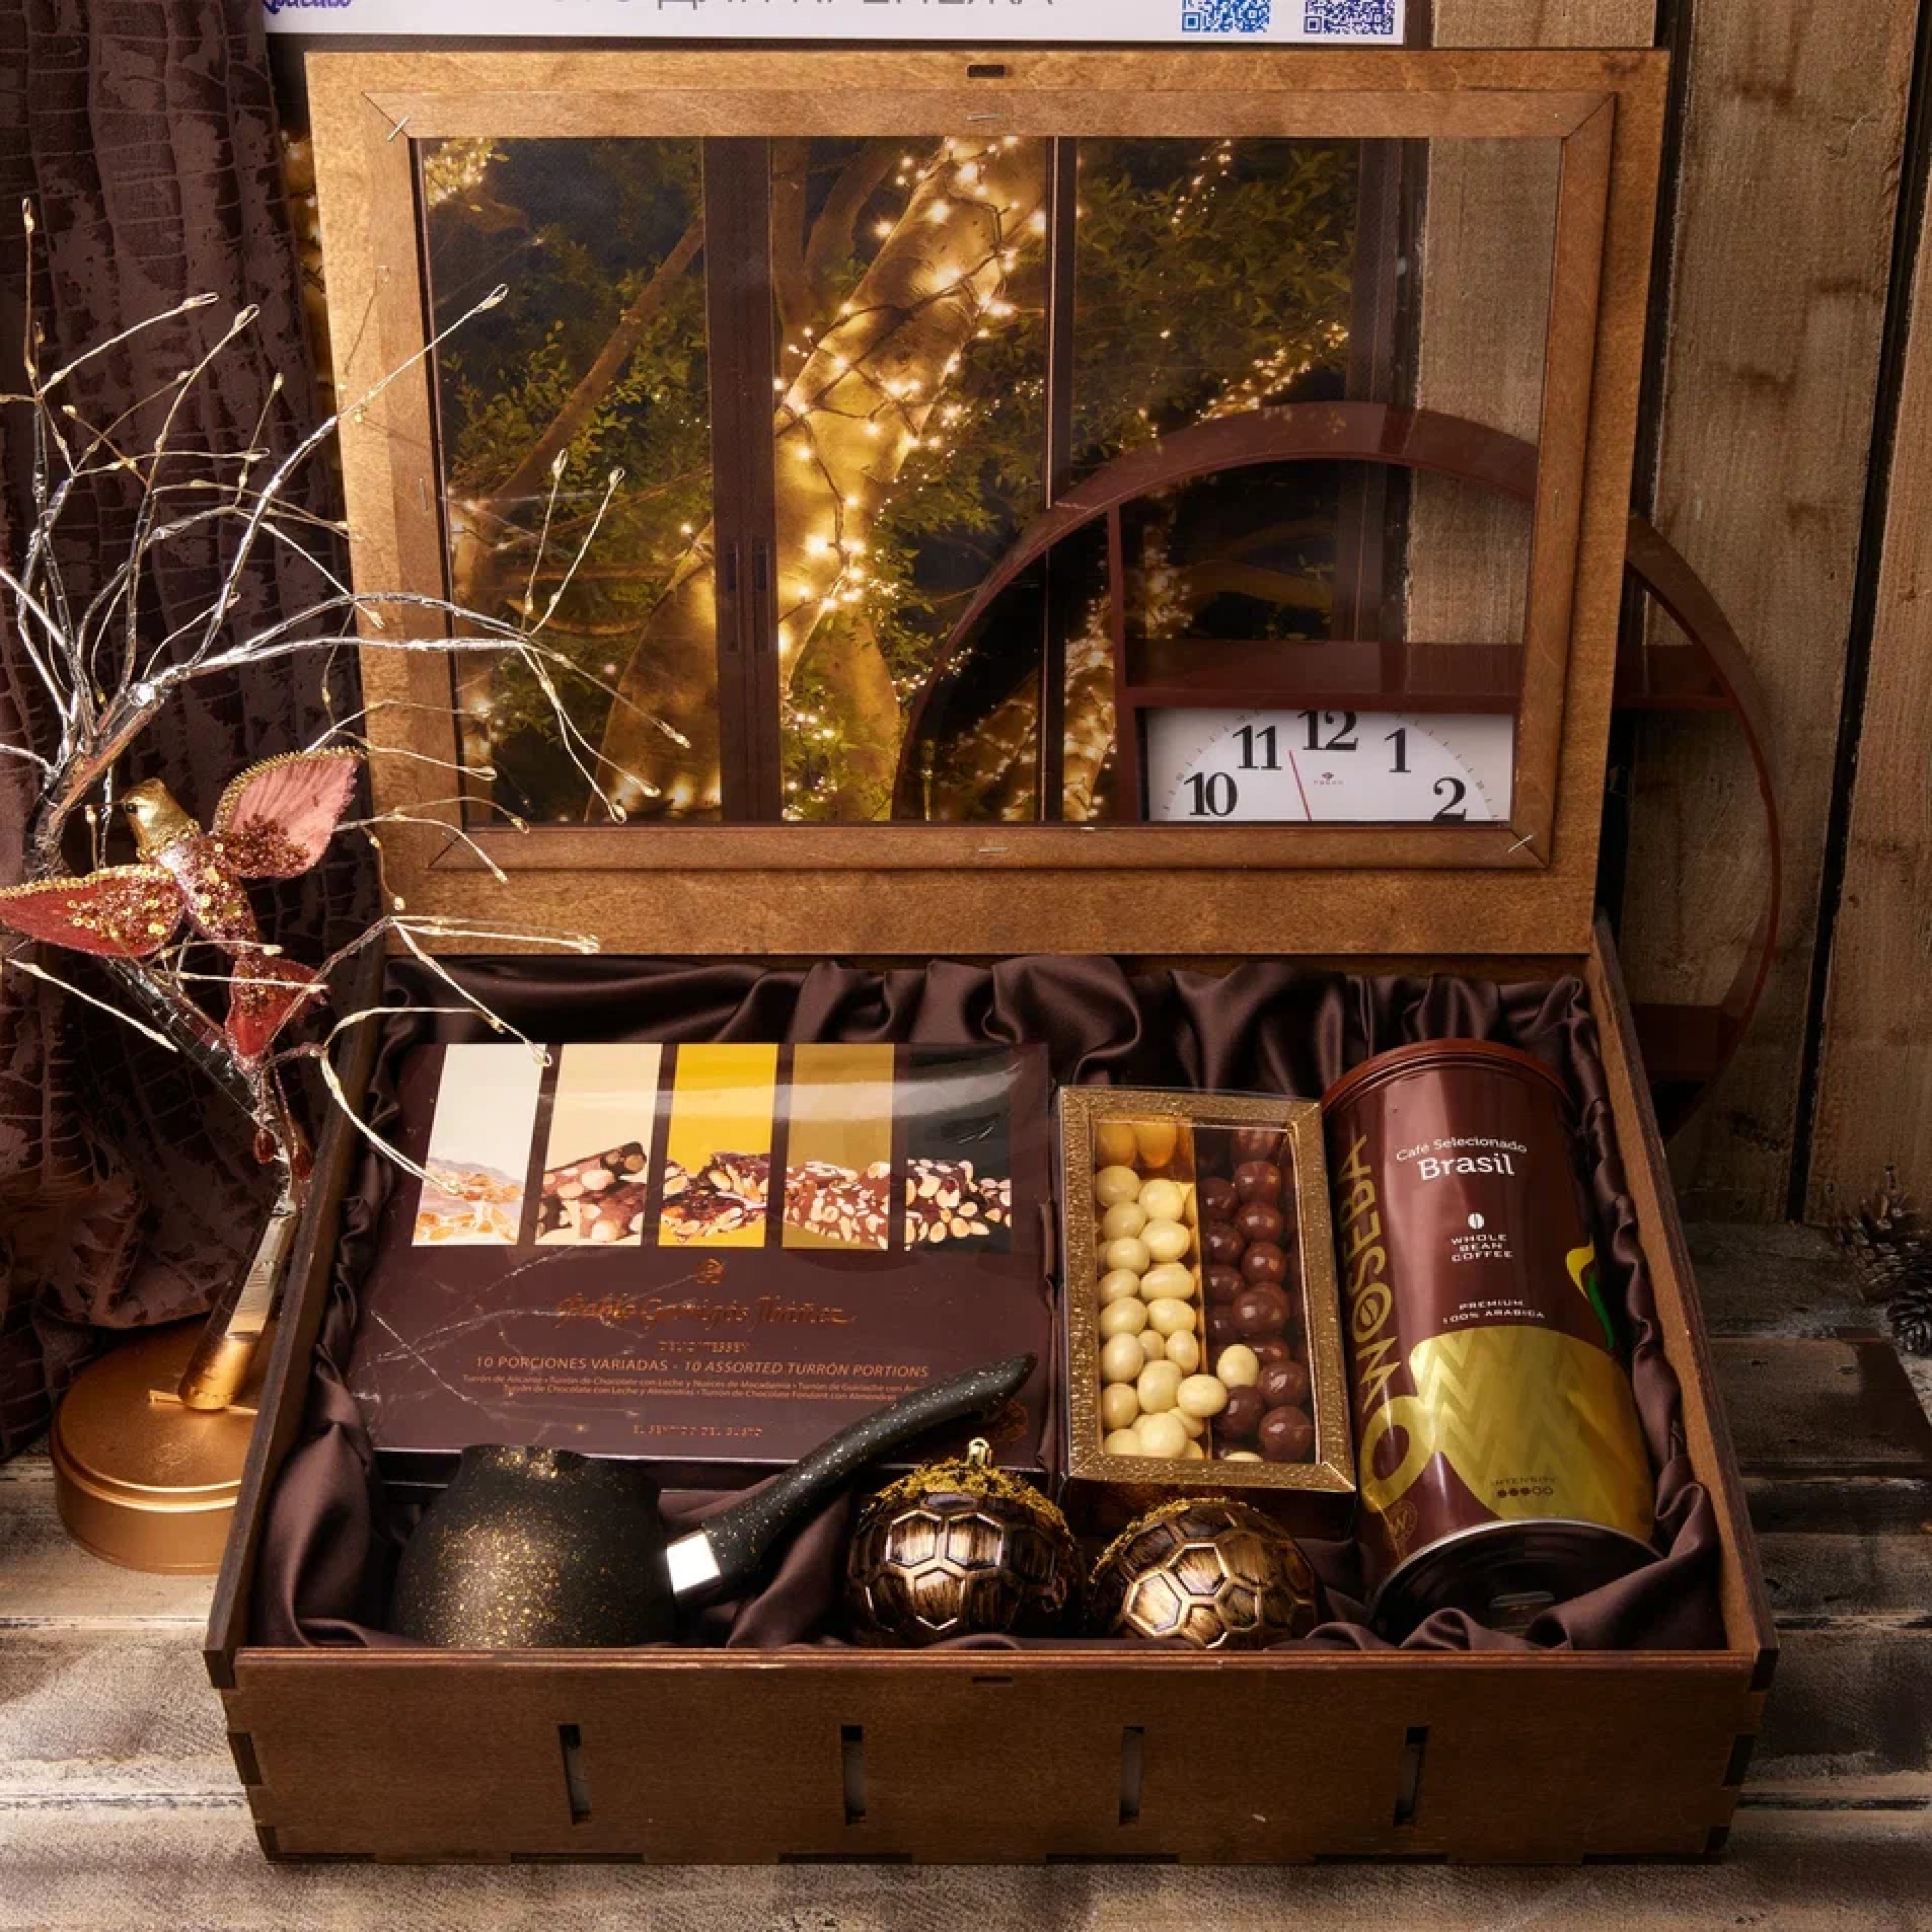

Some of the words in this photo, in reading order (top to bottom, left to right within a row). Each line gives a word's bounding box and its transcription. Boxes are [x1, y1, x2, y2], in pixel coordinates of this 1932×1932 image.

[1297, 710, 1358, 751] 12
[1232, 725, 1282, 771] 11
[1384, 728, 1411, 773] 1
[1183, 772, 1238, 818] 10
[1433, 777, 1466, 821] 2
[1433, 1137, 1527, 1154] Selecionado
[1417, 1153, 1515, 1180] Brasil
[1451, 1234, 1507, 1245] WHOLE
[1459, 1242, 1503, 1252] BEAN
[1451, 1250, 1513, 1262] COFFEE
[1337, 1134, 1401, 1413] WOSEBA
[1459, 1299, 1524, 1310] PREMIUM
[1484, 1308, 1546, 1319] ARABICA
[476, 1356, 493, 1368] 10
[497, 1356, 588, 1370] PORCIONES
[591, 1358, 668, 1372] VARIADAS
[684, 1361, 702, 1373] 10
[704, 1360, 783, 1374] ASSORTED
[852, 1365, 930, 1378] PORTIONS
